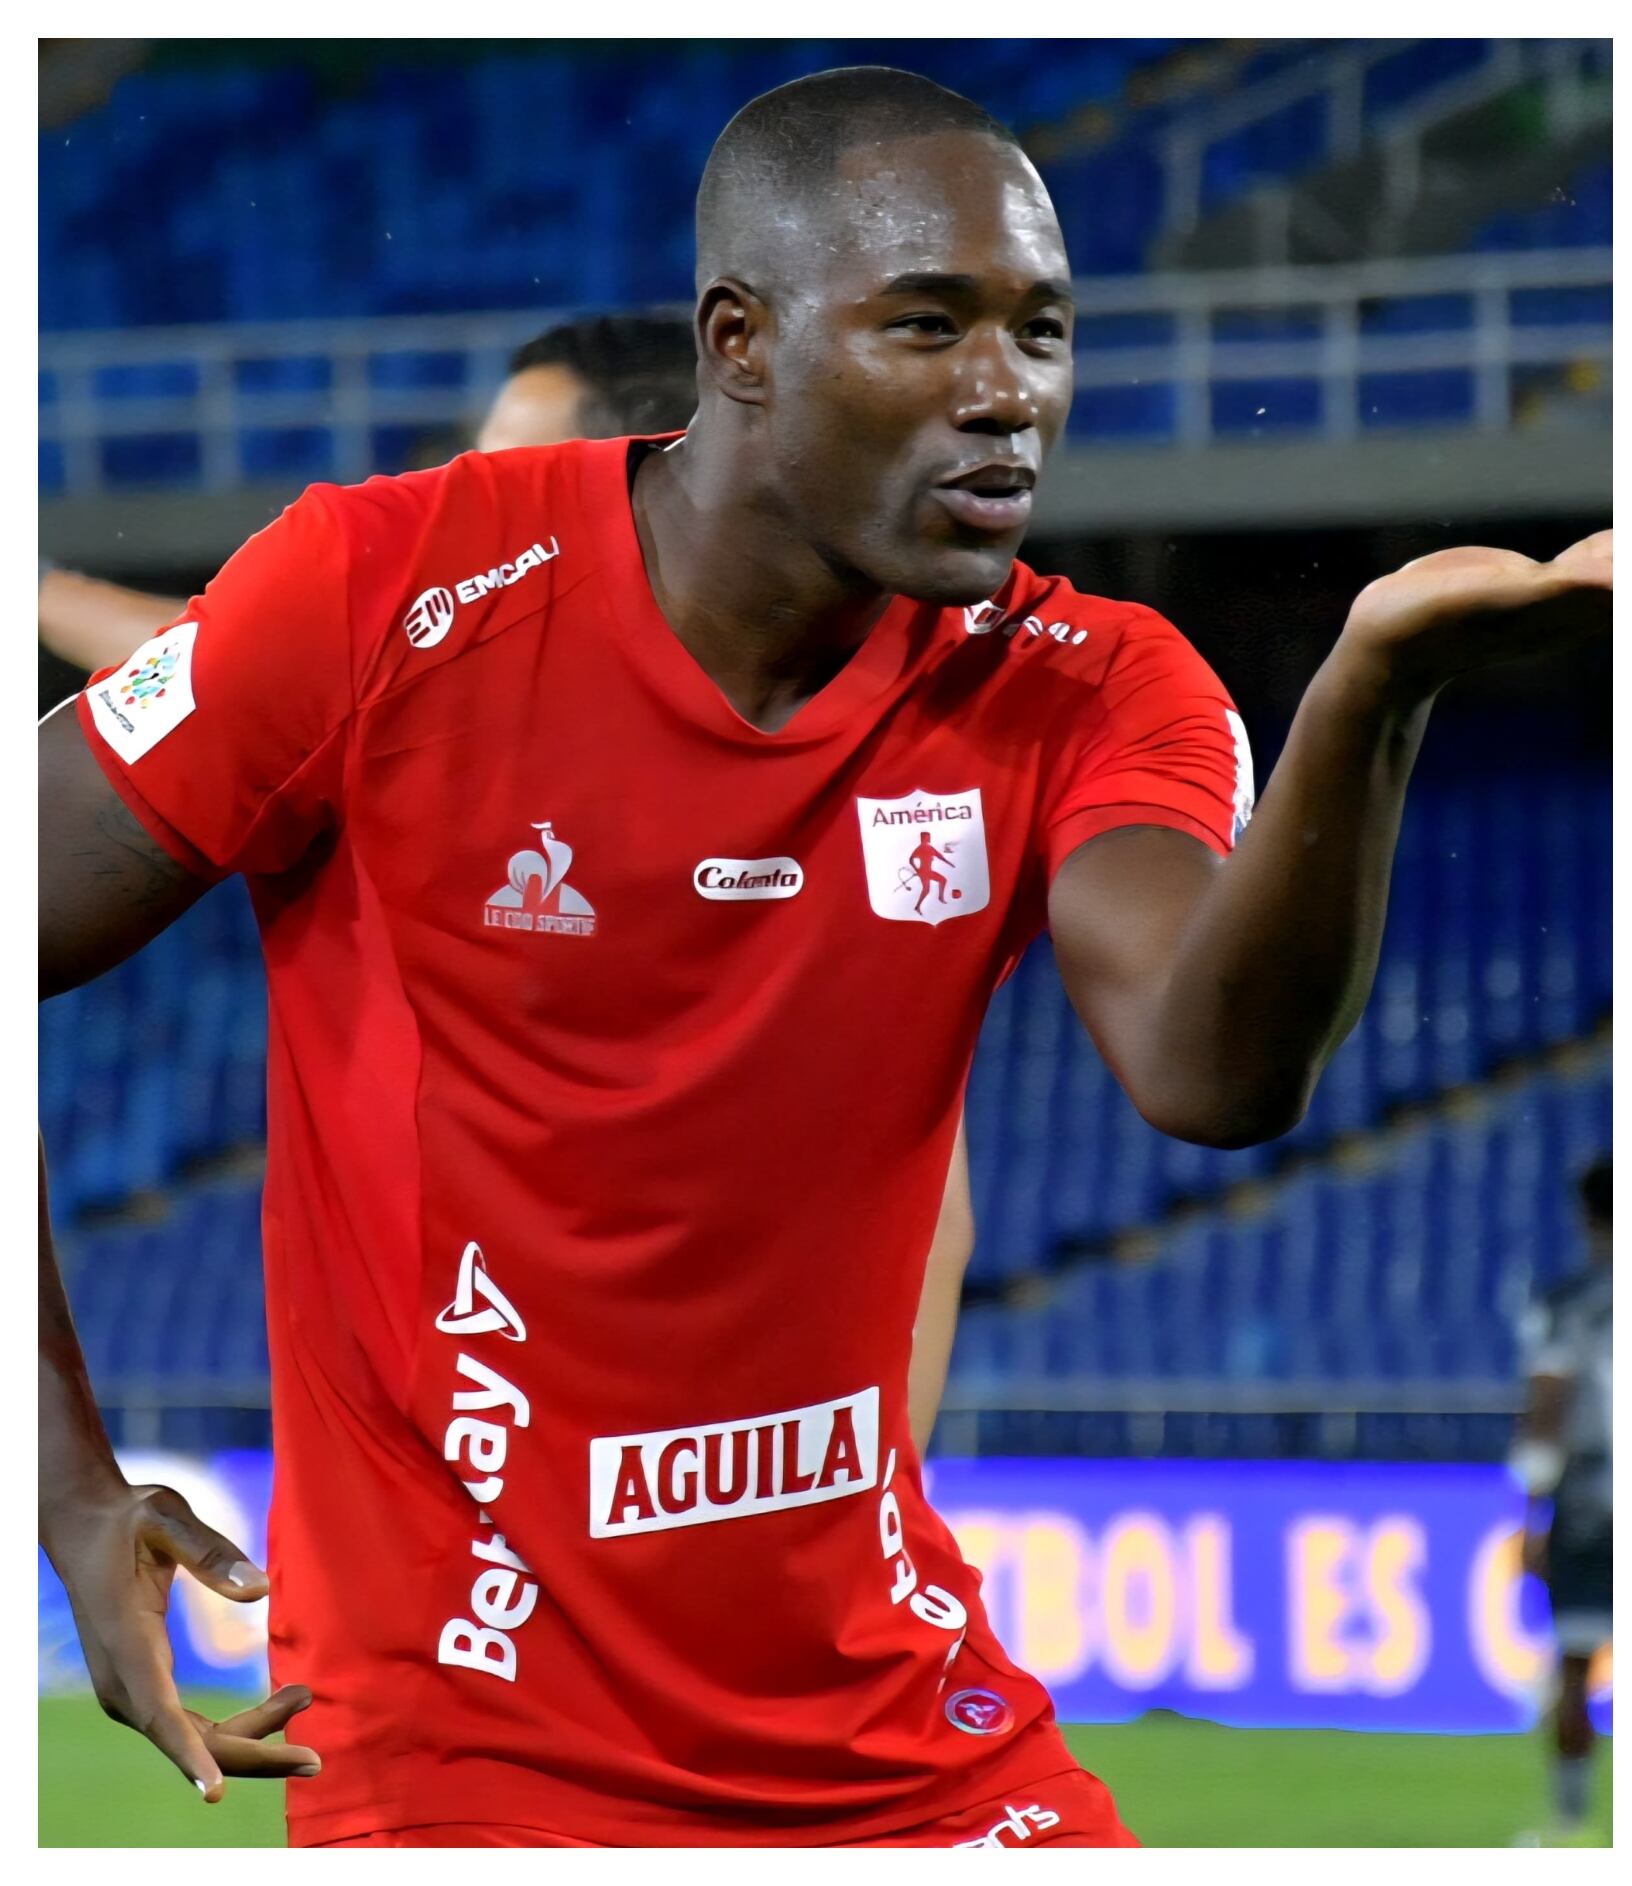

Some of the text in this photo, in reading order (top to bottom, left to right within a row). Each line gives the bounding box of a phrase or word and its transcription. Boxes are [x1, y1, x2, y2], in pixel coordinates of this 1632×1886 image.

[872, 801, 972, 828] América
[437, 1352, 539, 1683] Betlay
[606, 1406, 864, 1526] AGUILA
[1292, 1518, 1428, 1688] ES
